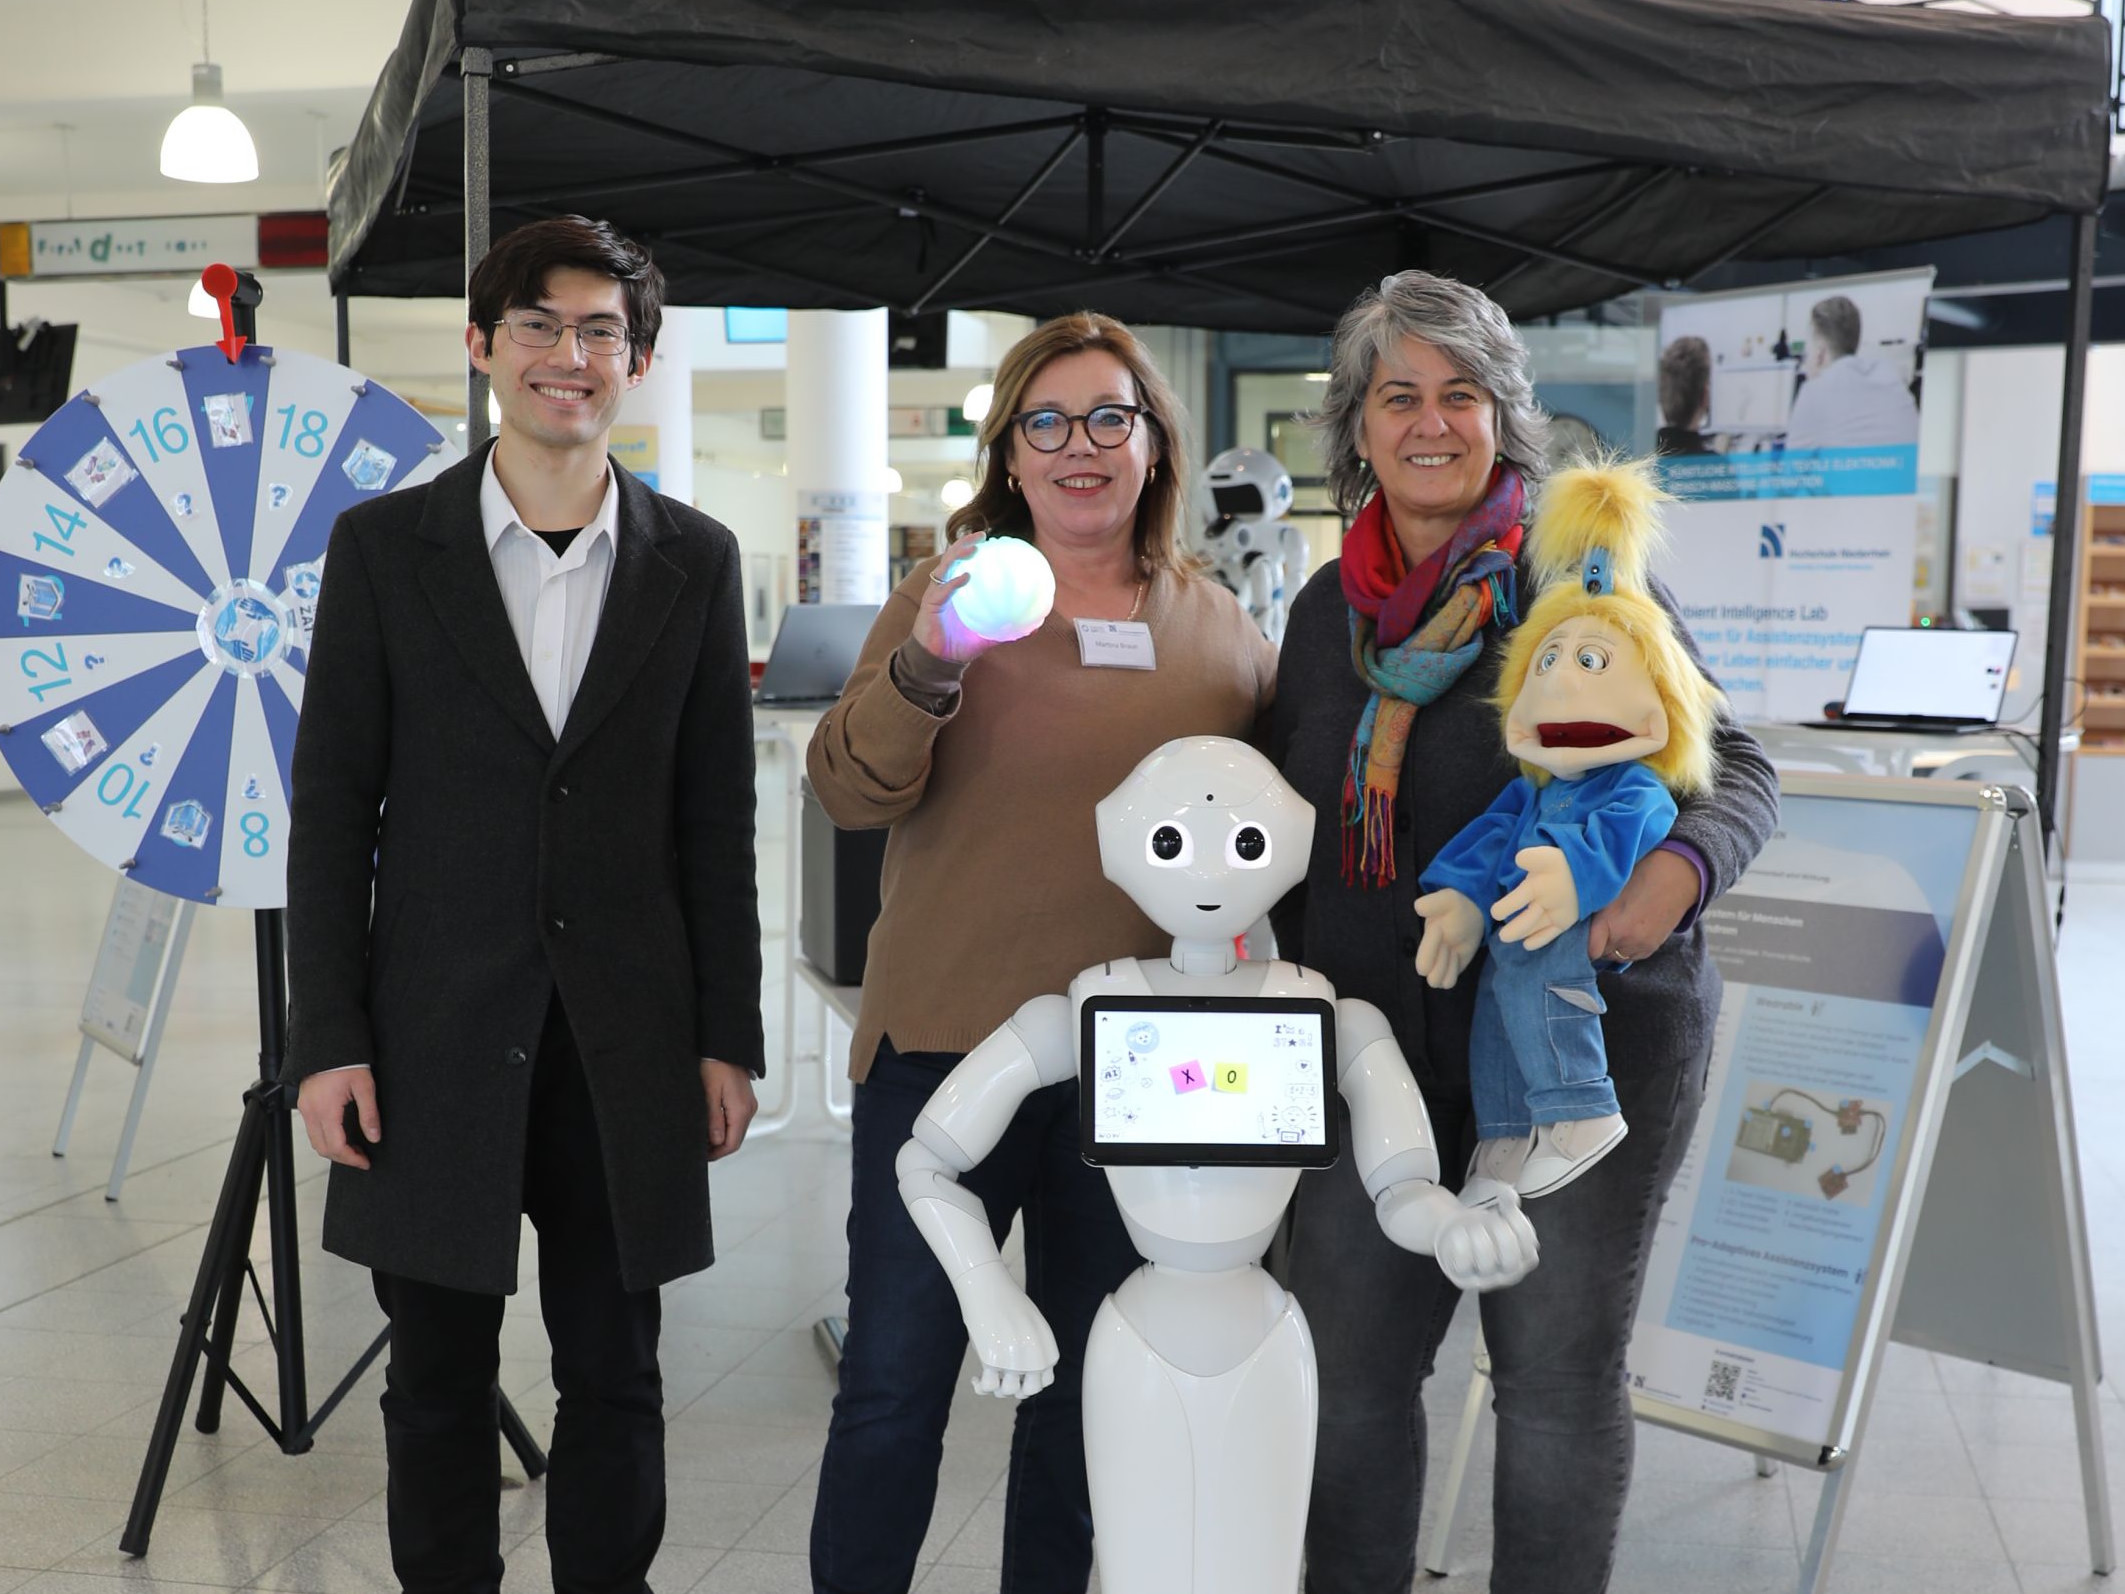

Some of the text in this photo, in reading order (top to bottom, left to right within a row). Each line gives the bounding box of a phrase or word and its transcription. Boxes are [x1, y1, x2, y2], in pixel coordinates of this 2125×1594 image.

[128, 407, 189, 463] 16
[277, 403, 328, 458] 18
[32, 503, 88, 557] 14
[1682, 604, 1829, 622] bient Intelligence Lab
[20, 642, 72, 702] 12
[97, 763, 150, 819] 10
[239, 811, 270, 858] 8
[1181, 1069, 1196, 1085] X
